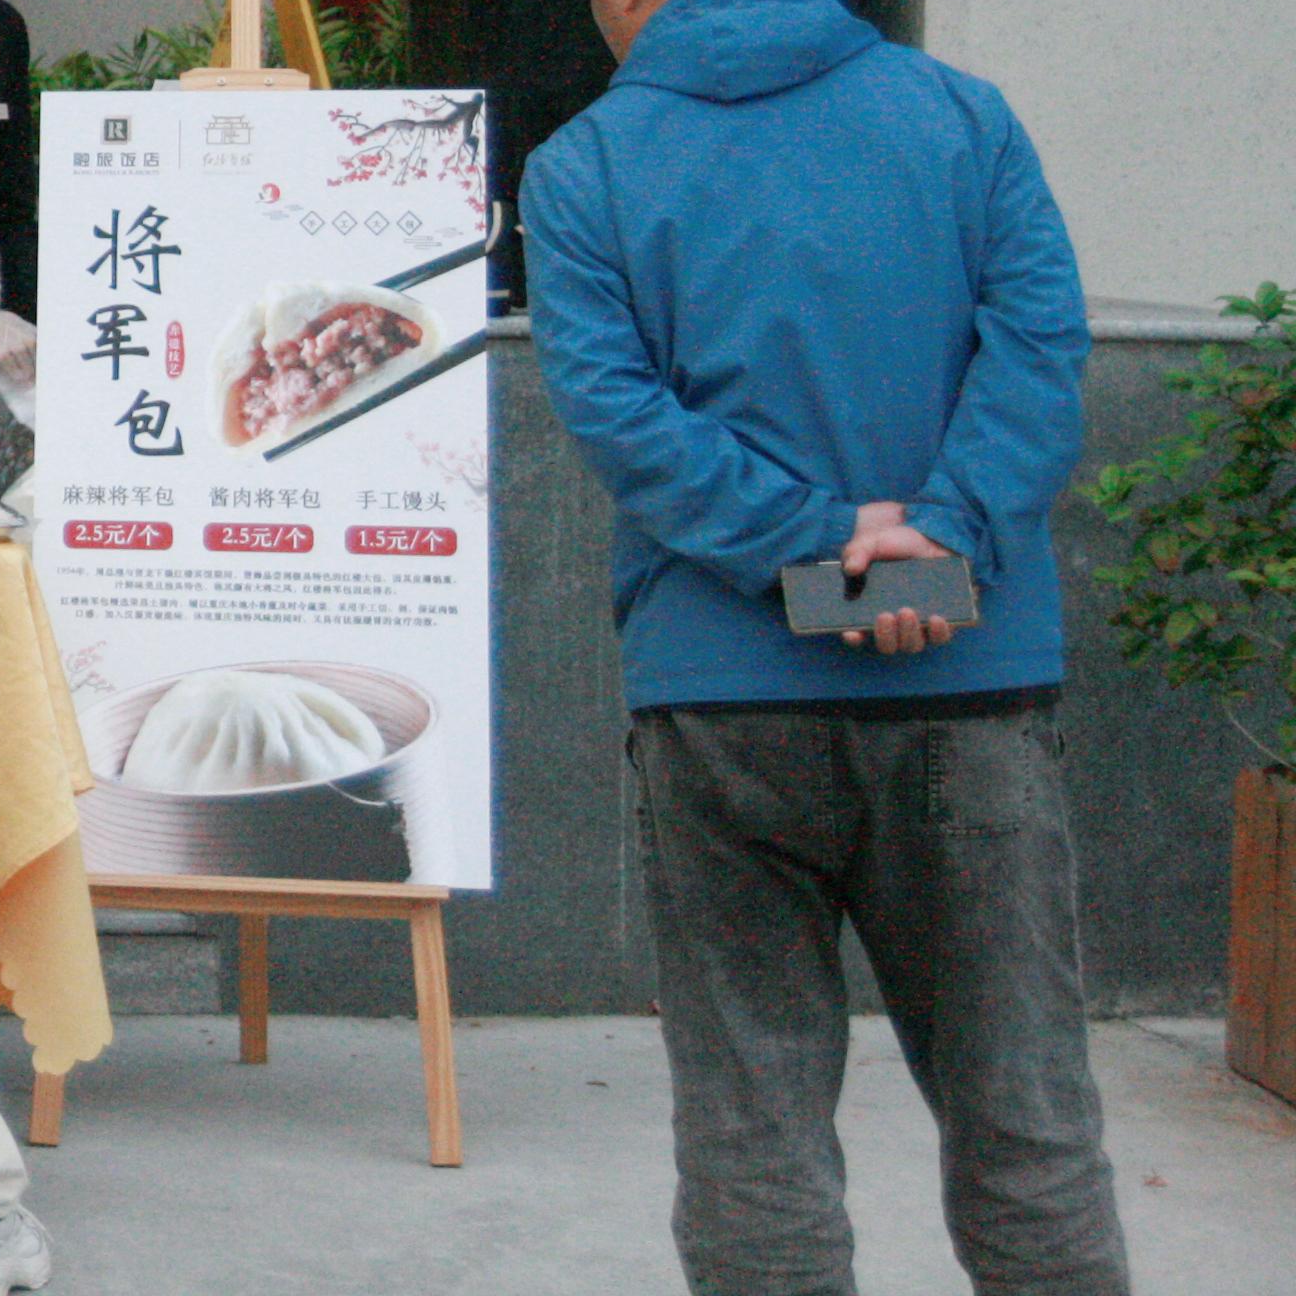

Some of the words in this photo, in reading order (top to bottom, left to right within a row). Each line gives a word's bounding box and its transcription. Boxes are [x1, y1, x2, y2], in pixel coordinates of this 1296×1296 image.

[80, 205, 185, 458] 将军包
[62, 485, 175, 507] 麻辣将军包
[209, 488, 321, 509] 酱肉将军包
[356, 490, 448, 512] 手工馒头
[74, 524, 161, 547] 2.5元/个
[221, 527, 307, 550] 2.5元/个
[359, 529, 444, 553] 1.5元/个
